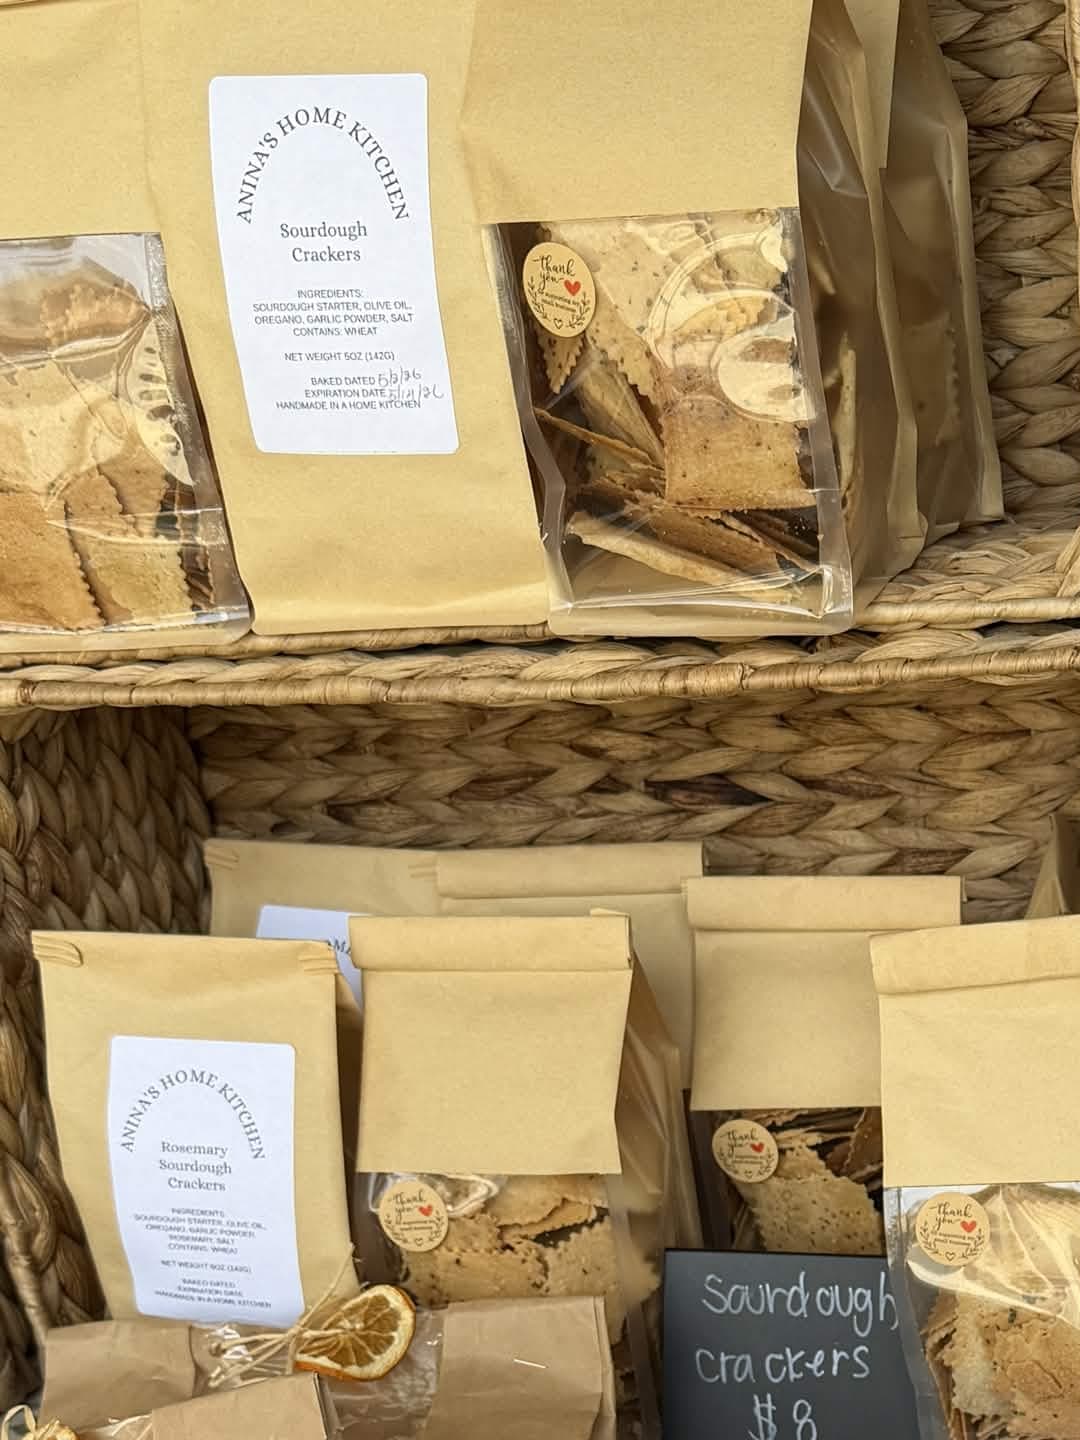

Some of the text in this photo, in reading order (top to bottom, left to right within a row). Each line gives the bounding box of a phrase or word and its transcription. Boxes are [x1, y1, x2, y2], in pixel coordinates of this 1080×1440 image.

[237, 107, 409, 223] ANINA'S HOME KITCHEN
[280, 220, 367, 240] Sourdough
[293, 246, 360, 262] Crackers
[297, 289, 363, 298] INGREDIENTS:
[253, 301, 391, 311] SOURDOUGH STARTER, OLIVE
[307, 315, 342, 324] GARLIC
[344, 314, 388, 323] POWDER,
[391, 313, 414, 322] SALT
[345, 327, 377, 335] WHEAT
[285, 352, 302, 361] NET
[305, 352, 341, 361] WEIGHT
[311, 377, 375, 385] BAKED DATED
[305, 389, 359, 398] EXPIRATION
[276, 400, 420, 410] HANDMADE HOME KITCHEN
[120, 1069, 266, 1160] ANINA'S HOME KITCHEN
[161, 1140, 228, 1158] Rosemary
[159, 1159, 232, 1175] Sourdough
[168, 1176, 226, 1191] Crackers
[702, 1271, 898, 1337] Sourdough
